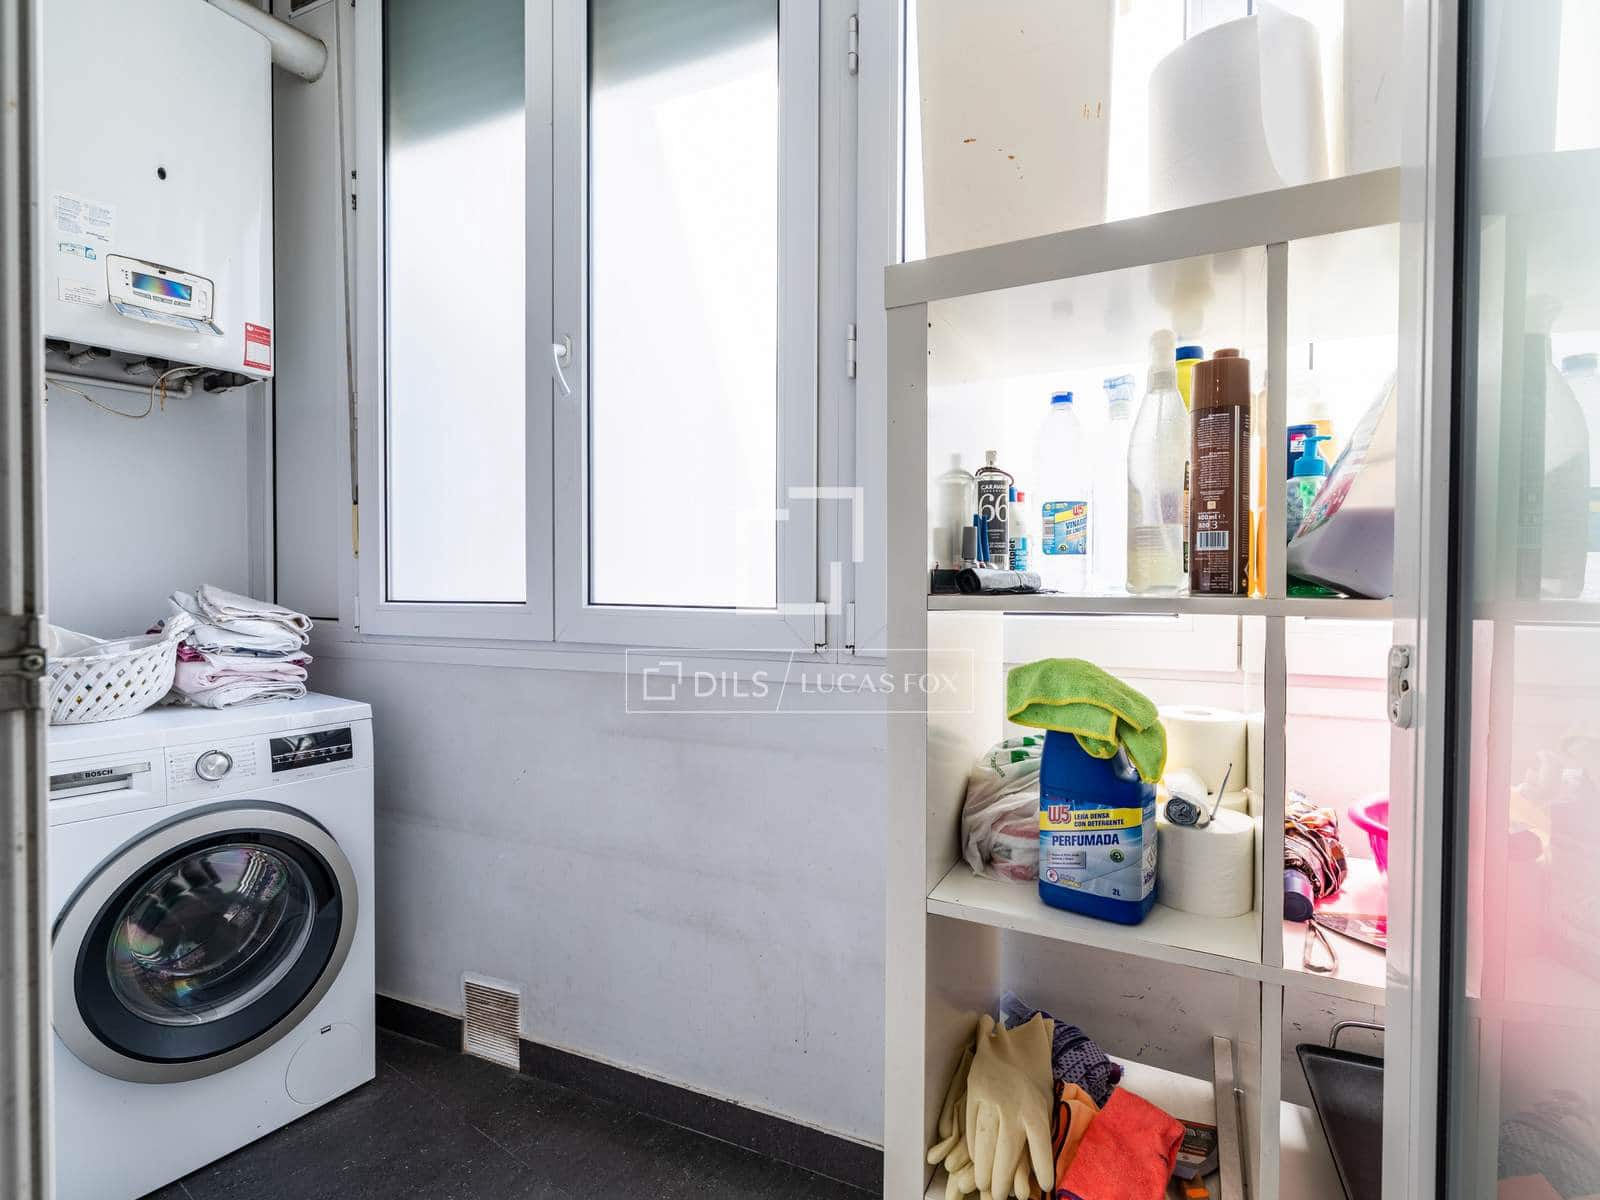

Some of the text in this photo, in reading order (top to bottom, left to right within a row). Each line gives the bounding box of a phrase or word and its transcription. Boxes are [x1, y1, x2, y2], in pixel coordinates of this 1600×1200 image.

[978, 493, 1008, 522] 66
[85, 769, 113, 778] BOSCH
[1048, 804, 1071, 824] W5
[1087, 819, 1124, 827] DETERGENTE
[1052, 834, 1120, 846] PERFUMADA
[1112, 888, 1121, 896] 2L
